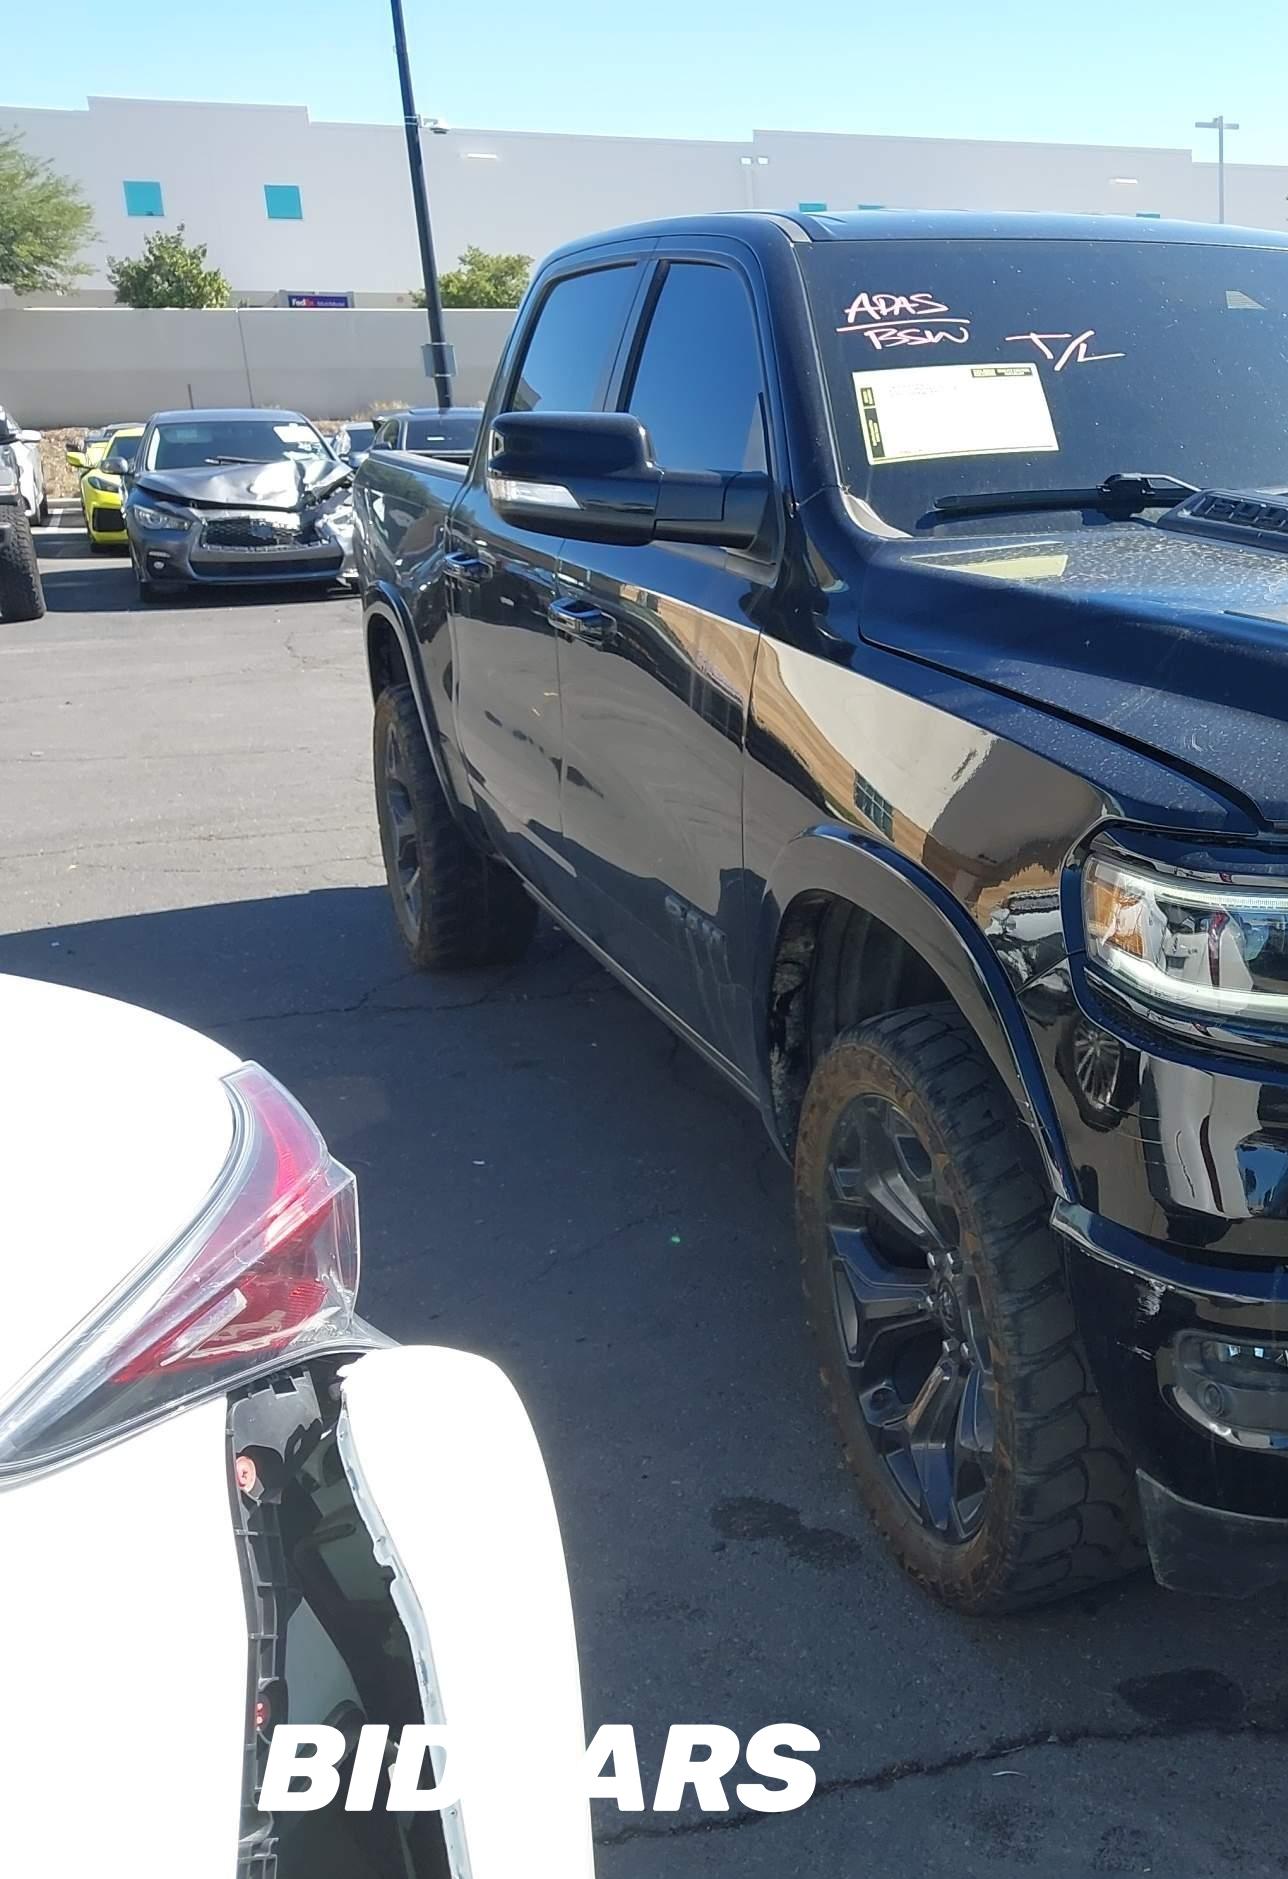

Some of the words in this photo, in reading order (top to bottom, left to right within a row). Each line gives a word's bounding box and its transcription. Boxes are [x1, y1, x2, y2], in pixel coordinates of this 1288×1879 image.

[844, 292, 949, 323] ADAS
[863, 326, 970, 350] BSW
[1004, 329, 1126, 372] T/L
